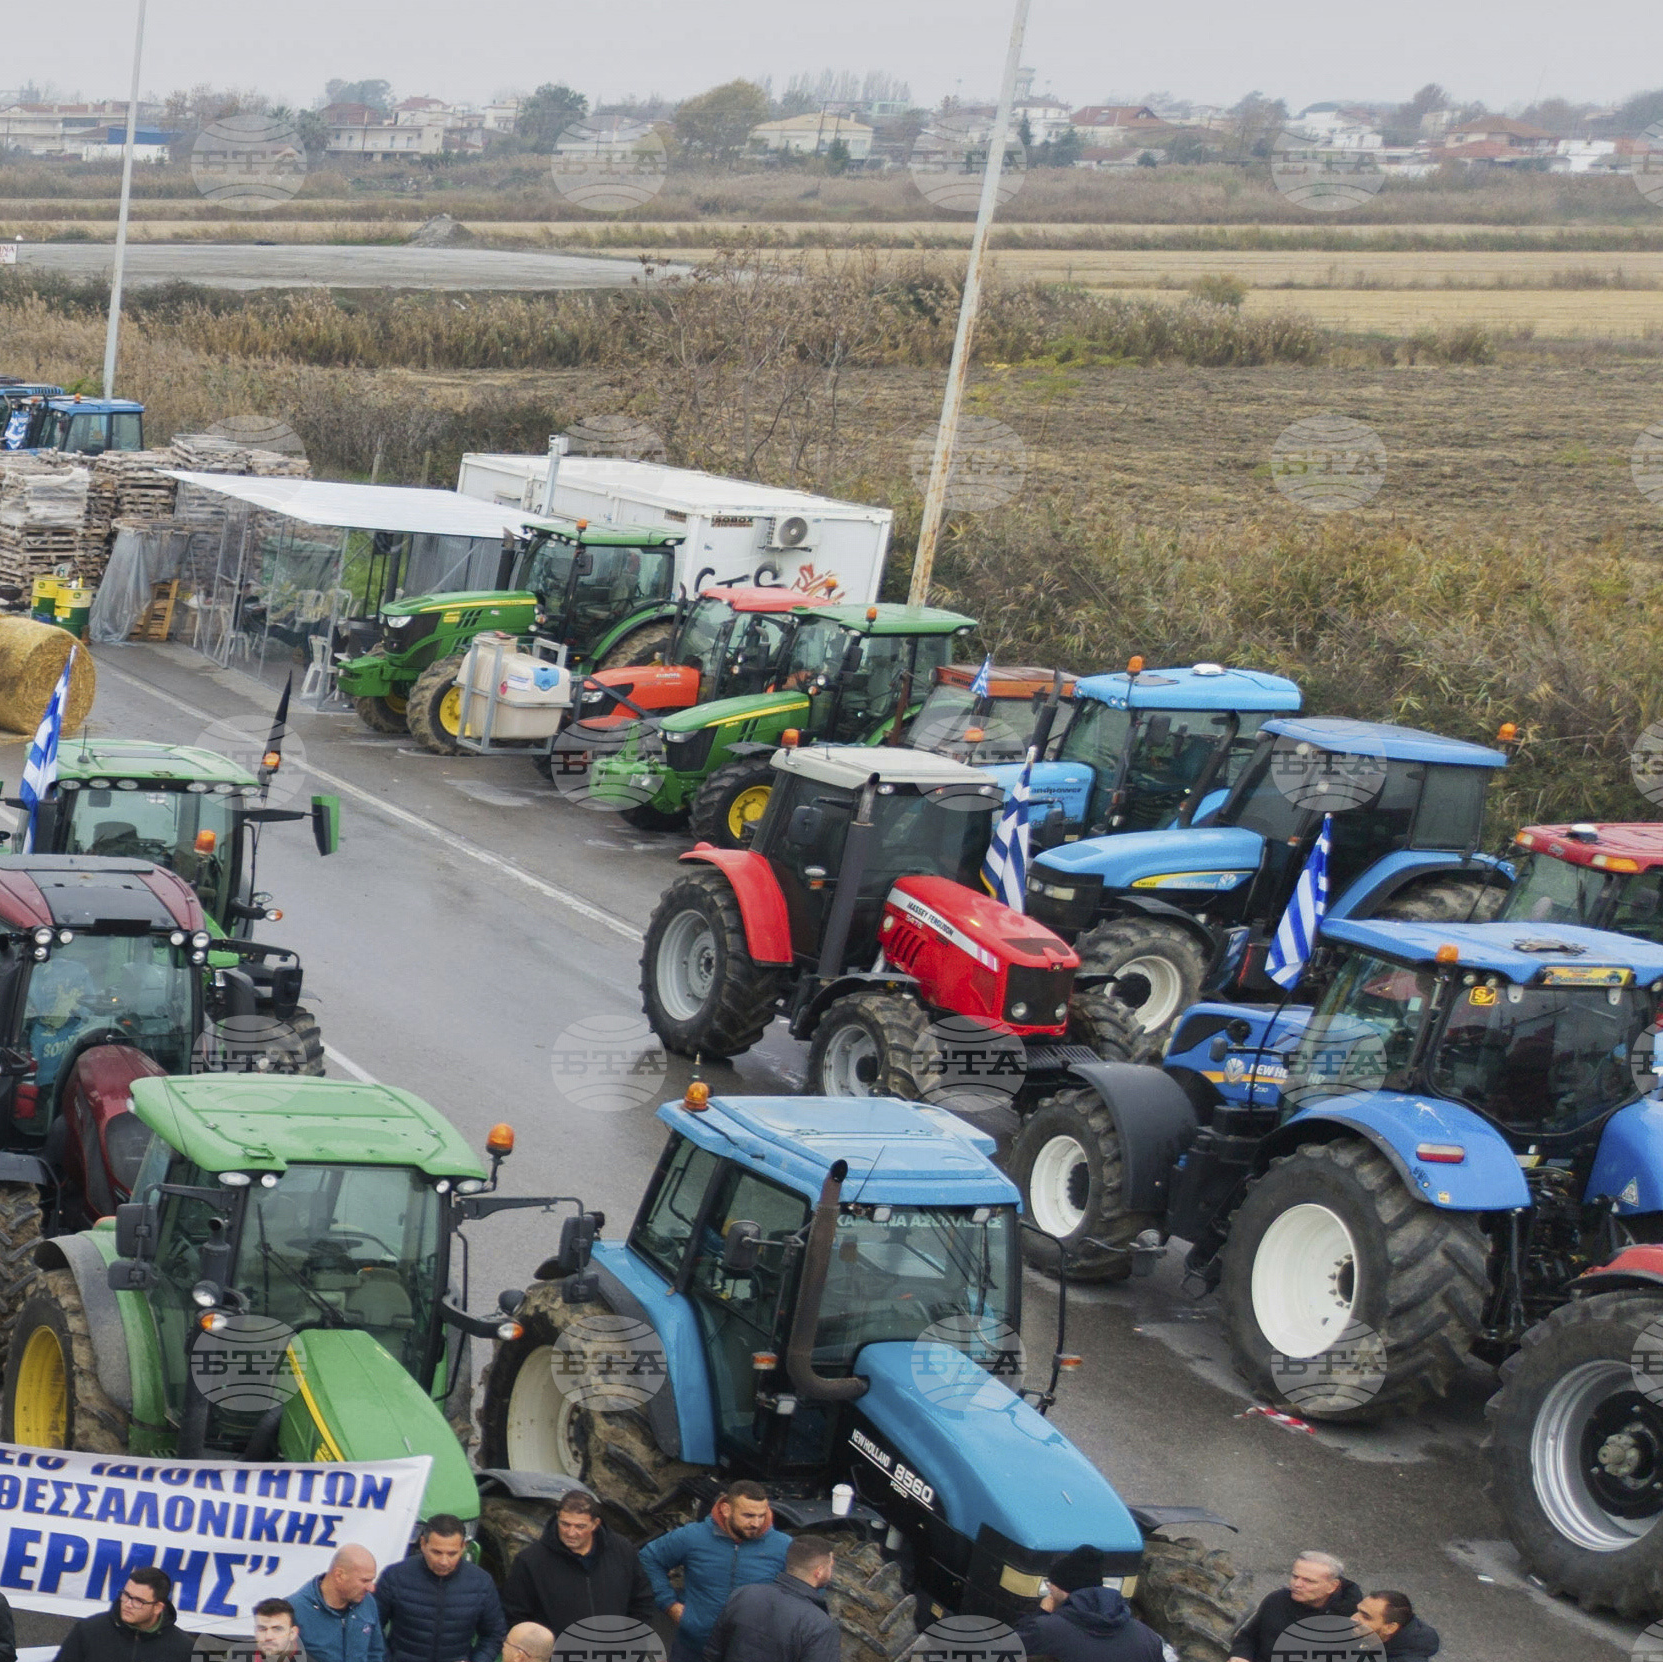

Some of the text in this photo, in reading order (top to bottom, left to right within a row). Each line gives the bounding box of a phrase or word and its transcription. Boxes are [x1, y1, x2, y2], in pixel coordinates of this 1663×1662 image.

[1030, 785, 1082, 796] andpower
[906, 901, 954, 937] MASSEY FERGUSON
[852, 1428, 934, 1504] NEW HOLLAND 8560
[890, 1480, 909, 1499] FORD
